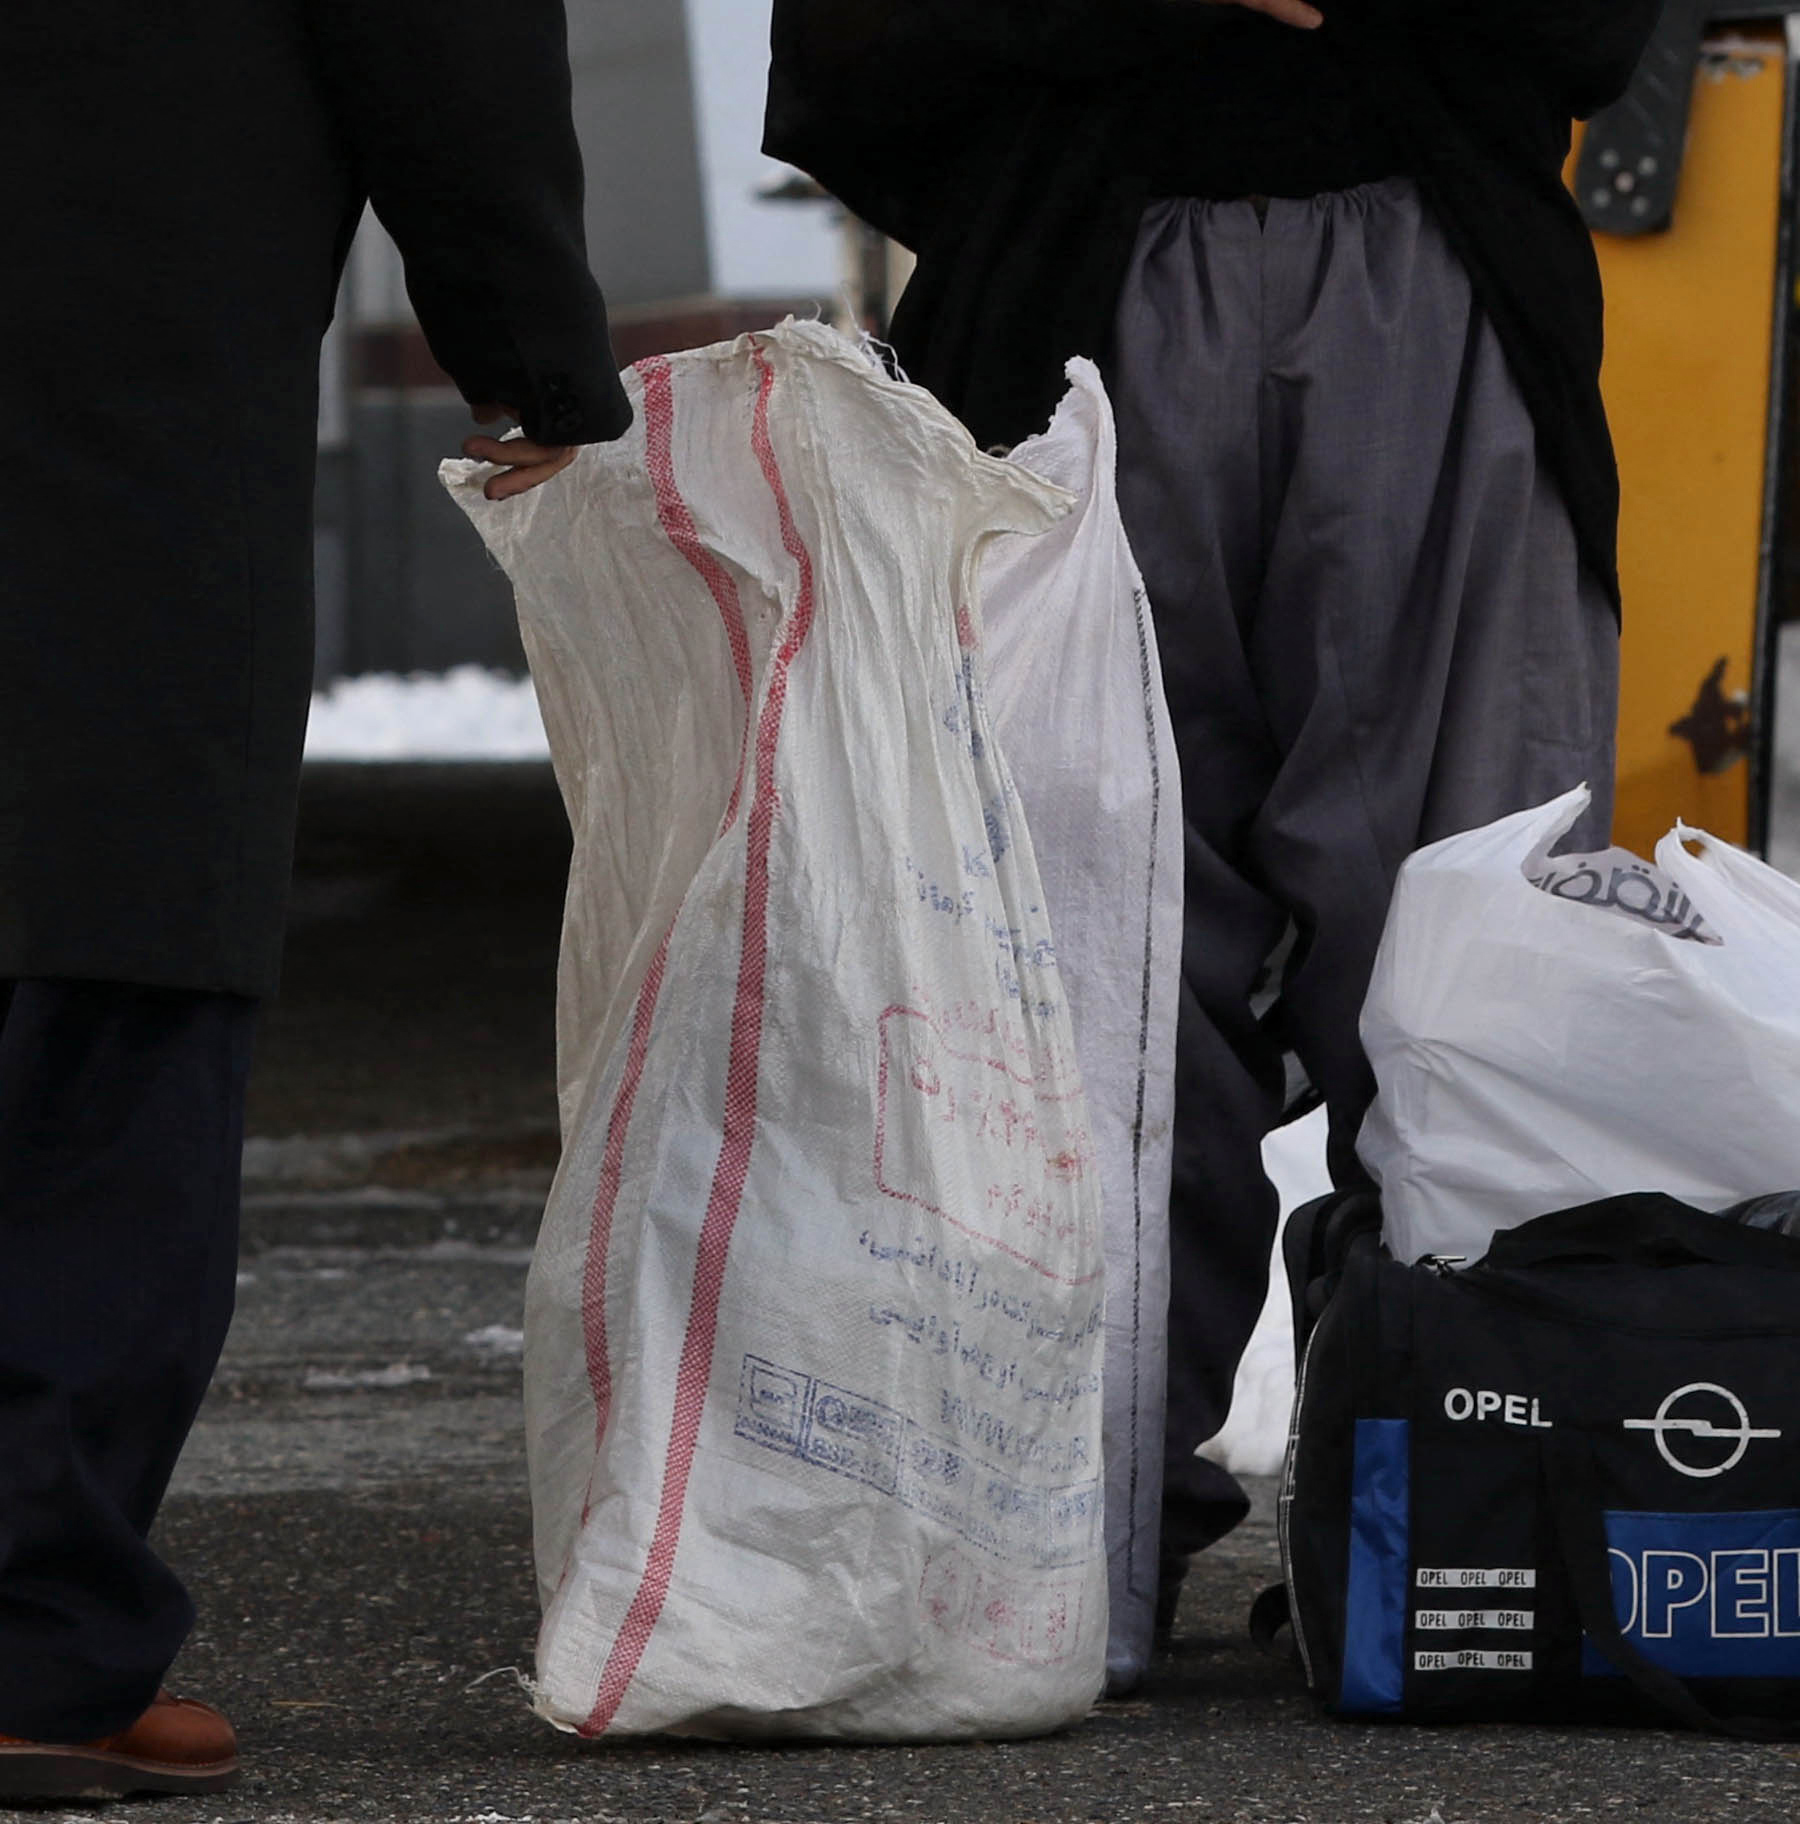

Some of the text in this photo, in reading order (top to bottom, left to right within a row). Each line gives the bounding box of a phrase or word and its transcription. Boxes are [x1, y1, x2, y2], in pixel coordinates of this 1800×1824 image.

[1444, 1387, 1553, 1428] OPEL
[1420, 1570, 1527, 1586] OPEL OPEL OPEL
[1420, 1612, 1526, 1627] OPEL OPEL OPEL
[1419, 1652, 1526, 1668] OPEL OPEL OPEL
